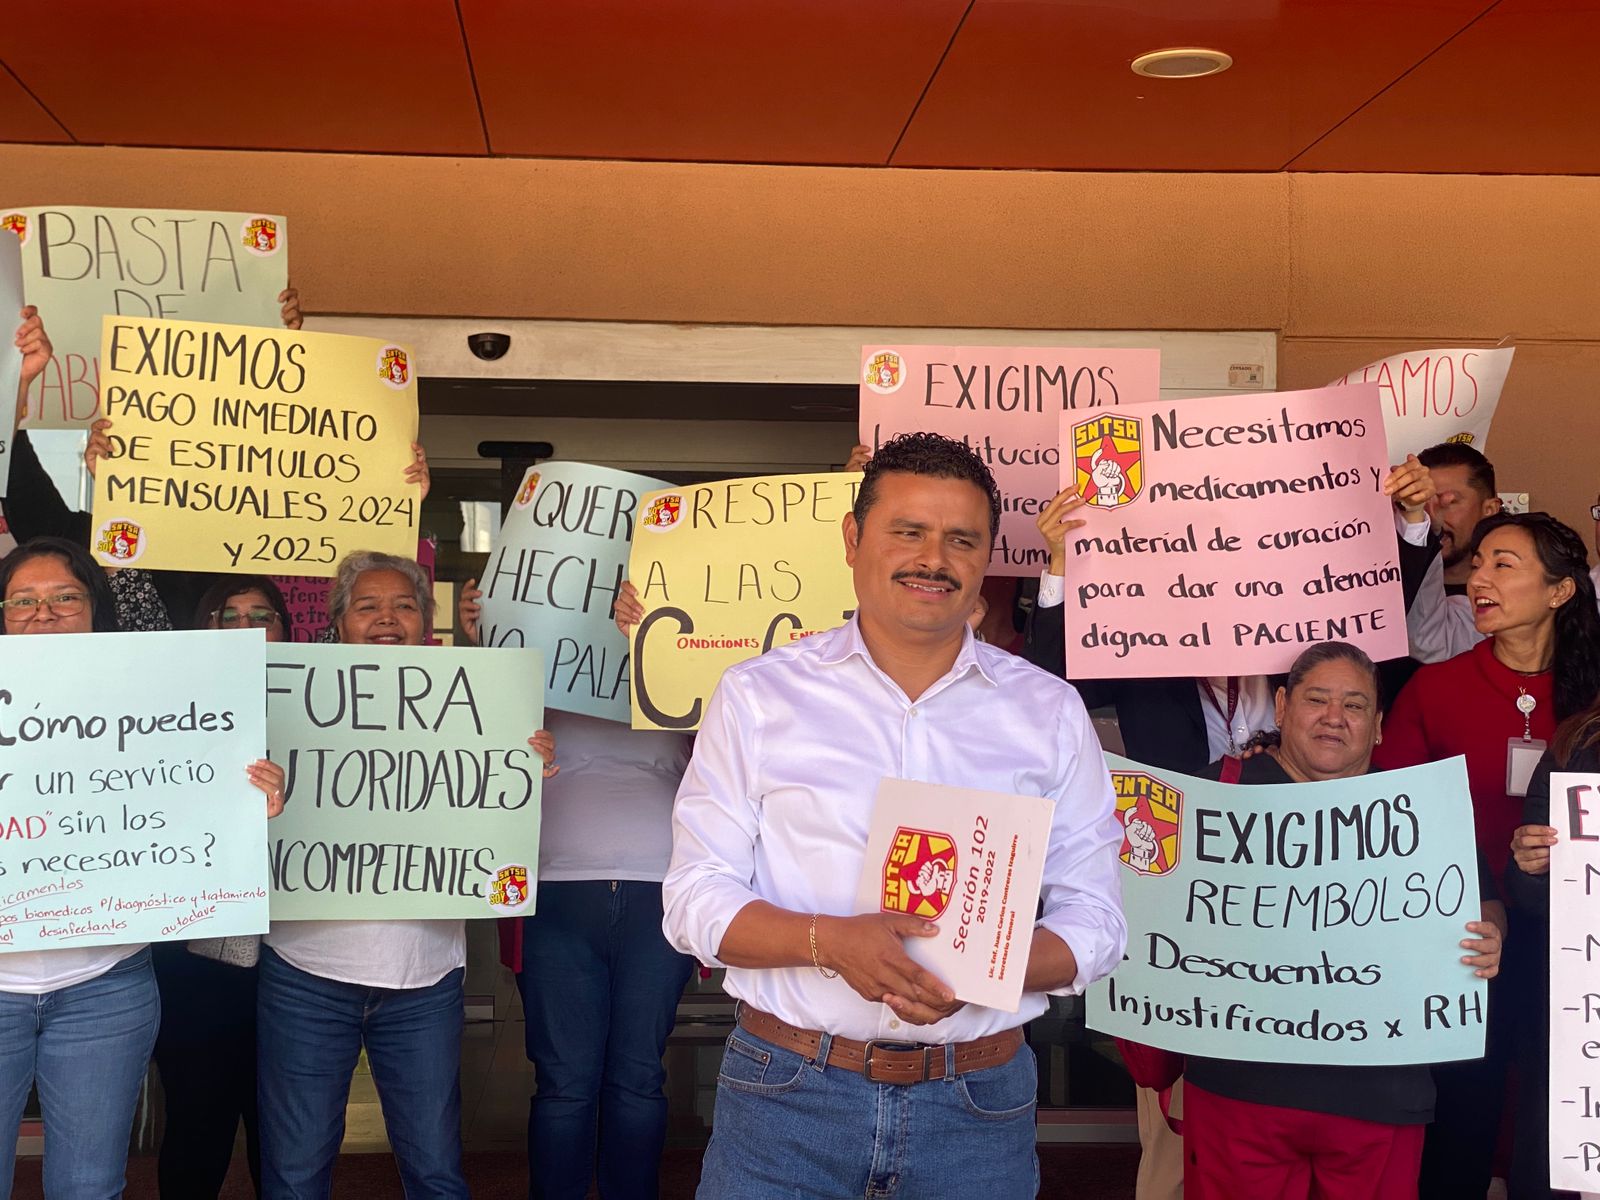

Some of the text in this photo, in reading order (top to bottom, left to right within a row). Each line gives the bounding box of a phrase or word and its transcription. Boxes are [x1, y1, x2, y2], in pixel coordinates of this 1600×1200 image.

[38, 212, 242, 292] BASTA
[110, 325, 306, 393] EXIGIMOS
[924, 363, 1119, 413] EXIGIMOS
[106, 386, 377, 442] PAGO INMEDIATO
[1075, 417, 1139, 446] SNTSA
[1151, 408, 1366, 451] Necesitamos
[106, 435, 361, 483] DE ESTIMULOS
[1149, 461, 1361, 502] medicamentos
[107, 474, 413, 528] MENSUALES 2024
[111, 522, 139, 535] SNTSA
[251, 534, 337, 563] 2025
[1074, 517, 1371, 556] material de curación
[643, 560, 802, 604] A LAS
[1078, 560, 1400, 608] para dar una atención
[1081, 608, 1387, 658] digna al PACIENTE
[266, 664, 483, 736] FUERA
[118, 701, 235, 752] puedes
[35, 770, 74, 795] un
[89, 759, 215, 793] servicio
[1112, 774, 1179, 810] SNTSA
[58, 811, 106, 835] sin
[123, 804, 166, 830] los
[1195, 793, 1419, 869] EXIGIMOS
[22, 832, 216, 874] necesarios?
[498, 867, 527, 880] SNTSA
[885, 833, 913, 910] SNTSA
[25, 905, 93, 919] biomedicos
[190, 895, 197, 906] y
[201, 886, 266, 902] tratamiento
[953, 815, 989, 954] Sección 102
[976, 850, 996, 924] 2019-2022
[998, 906, 1006, 929] Carlos
[1002, 868, 1012, 904] Contreras
[1185, 863, 1465, 932] REEMBOLSO
[39, 918, 128, 938] desinfectantes
[161, 904, 217, 935] autoclave
[998, 911, 1015, 980] Secretario General
[1108, 977, 1368, 1042] Injustificados
[1423, 990, 1483, 1031] RH
